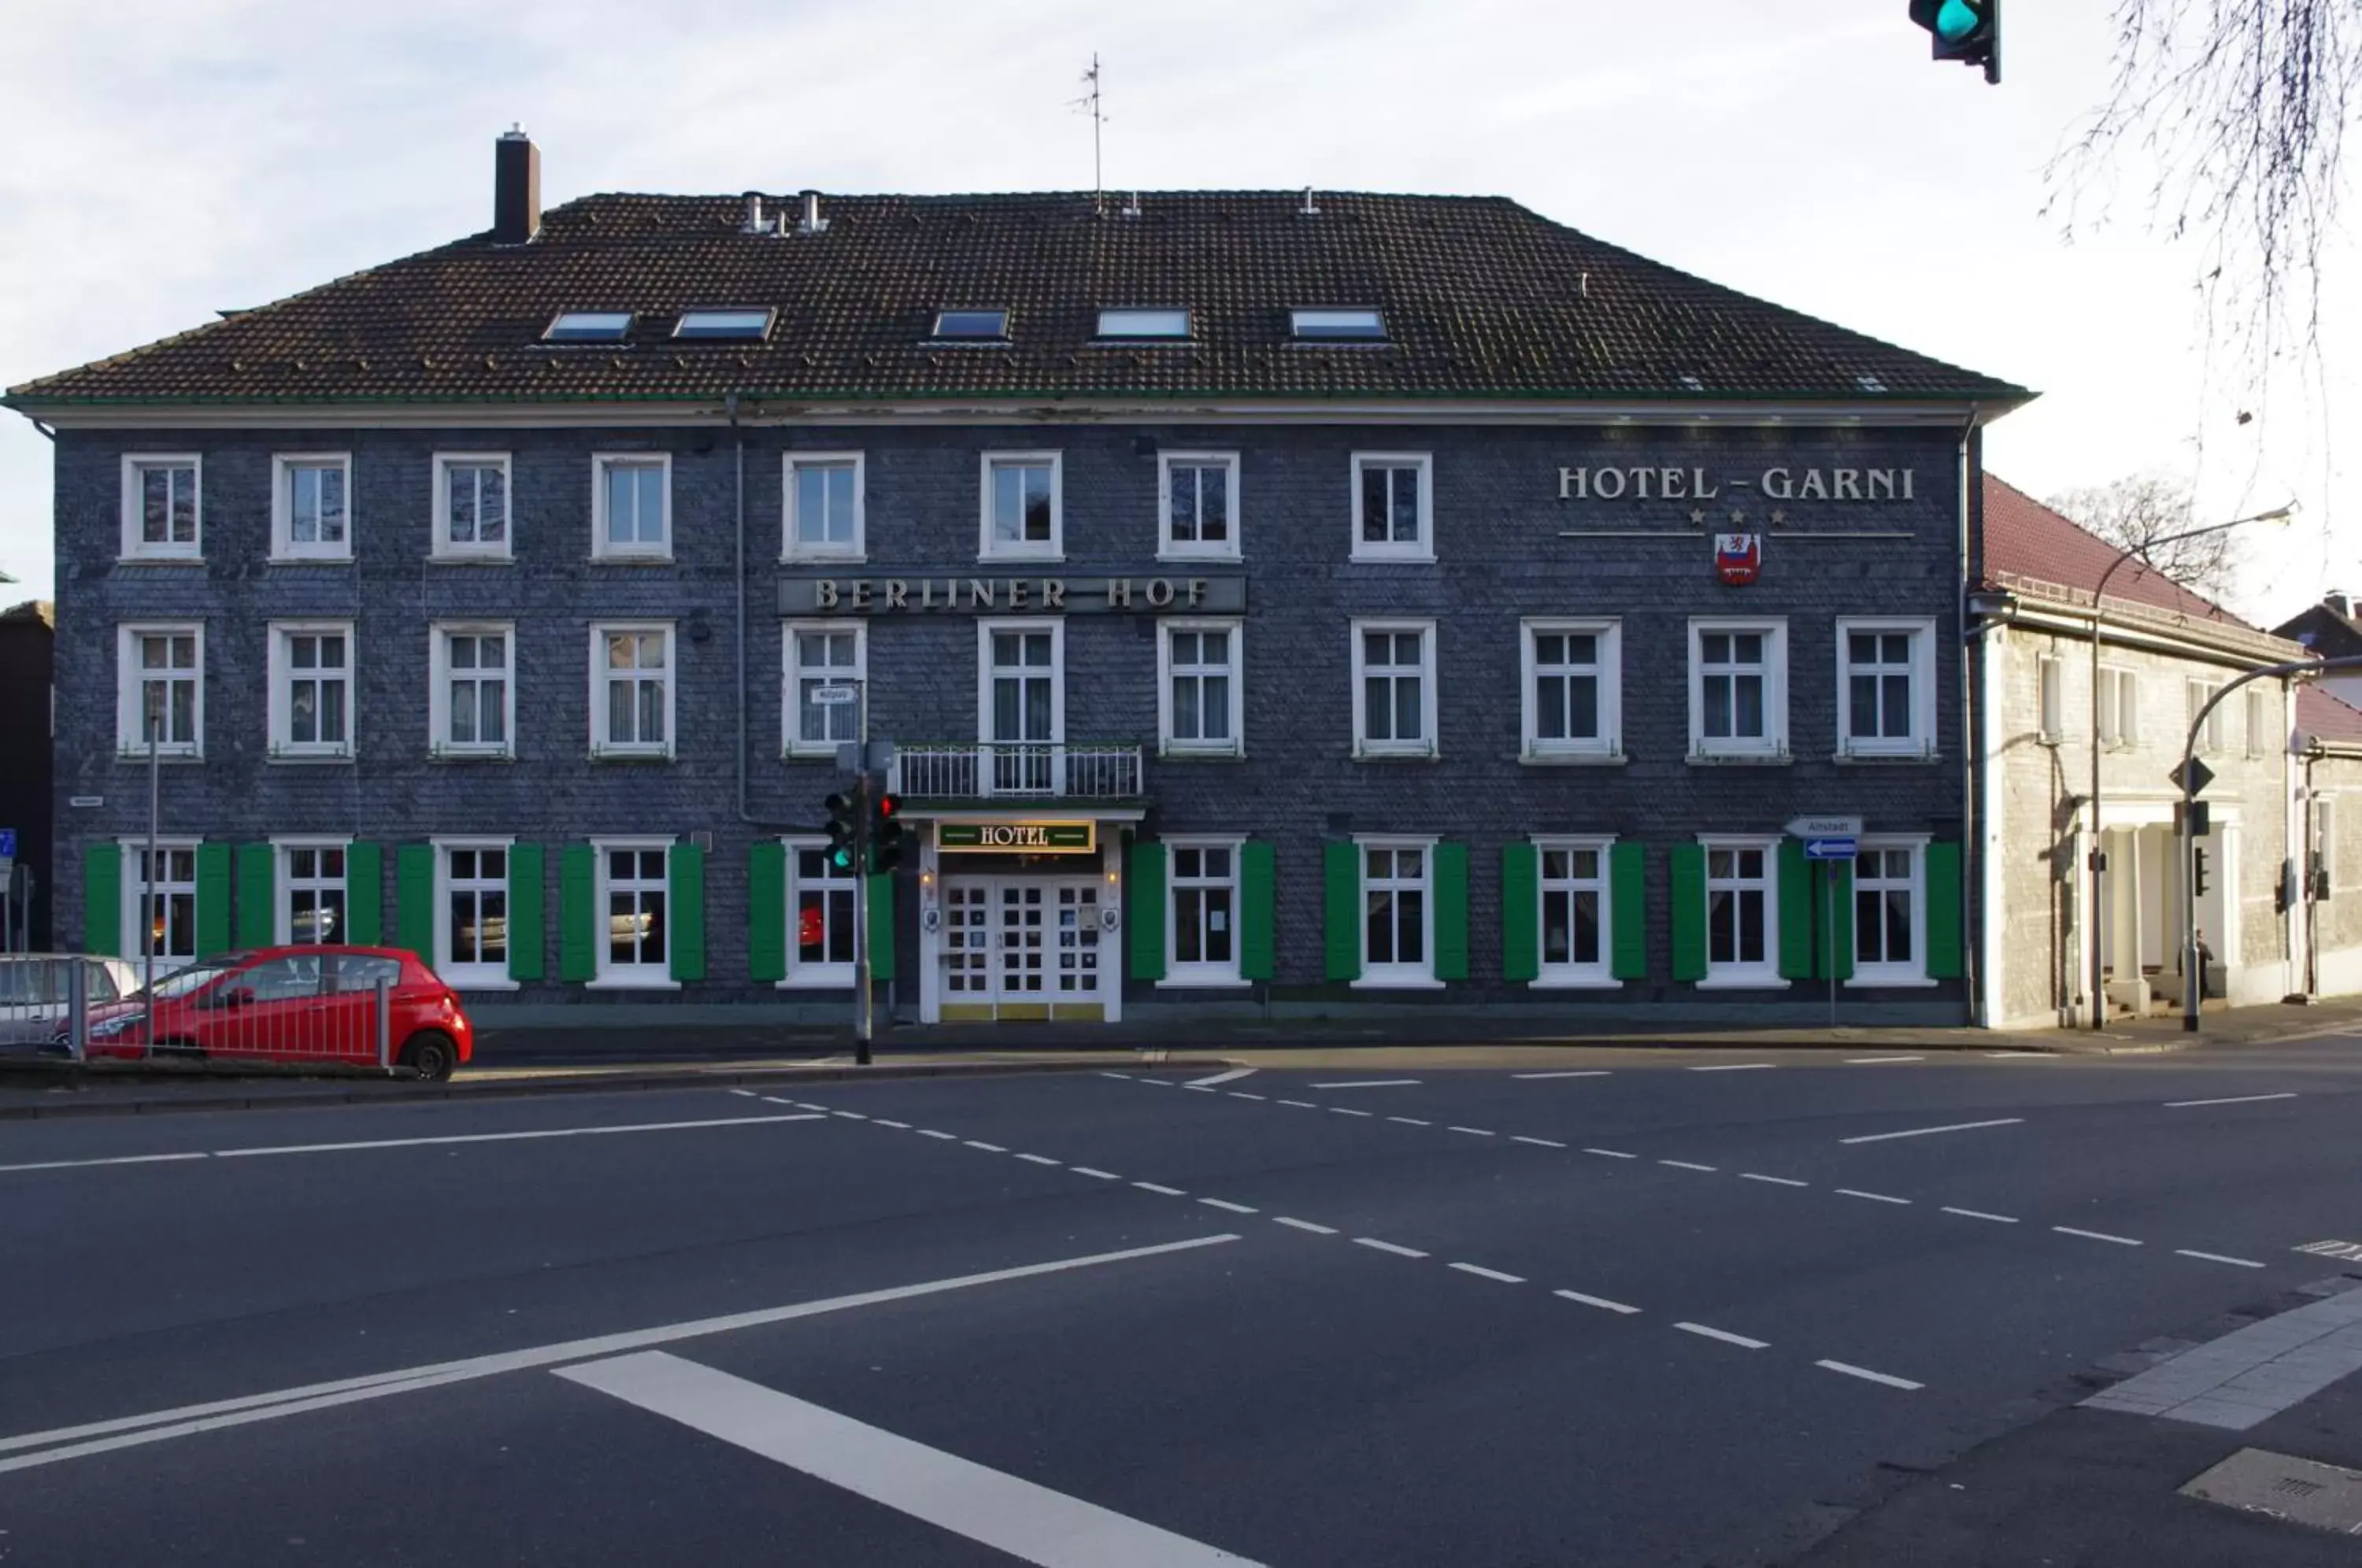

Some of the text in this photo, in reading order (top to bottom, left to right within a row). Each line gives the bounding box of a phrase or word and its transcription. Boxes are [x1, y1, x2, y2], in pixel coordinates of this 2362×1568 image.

[1558, 467, 1718, 499] HOTEL
[1761, 468, 1914, 500] GARNI
[816, 578, 1207, 607] BERLINER HOF
[980, 827, 1049, 845] HOTEL
